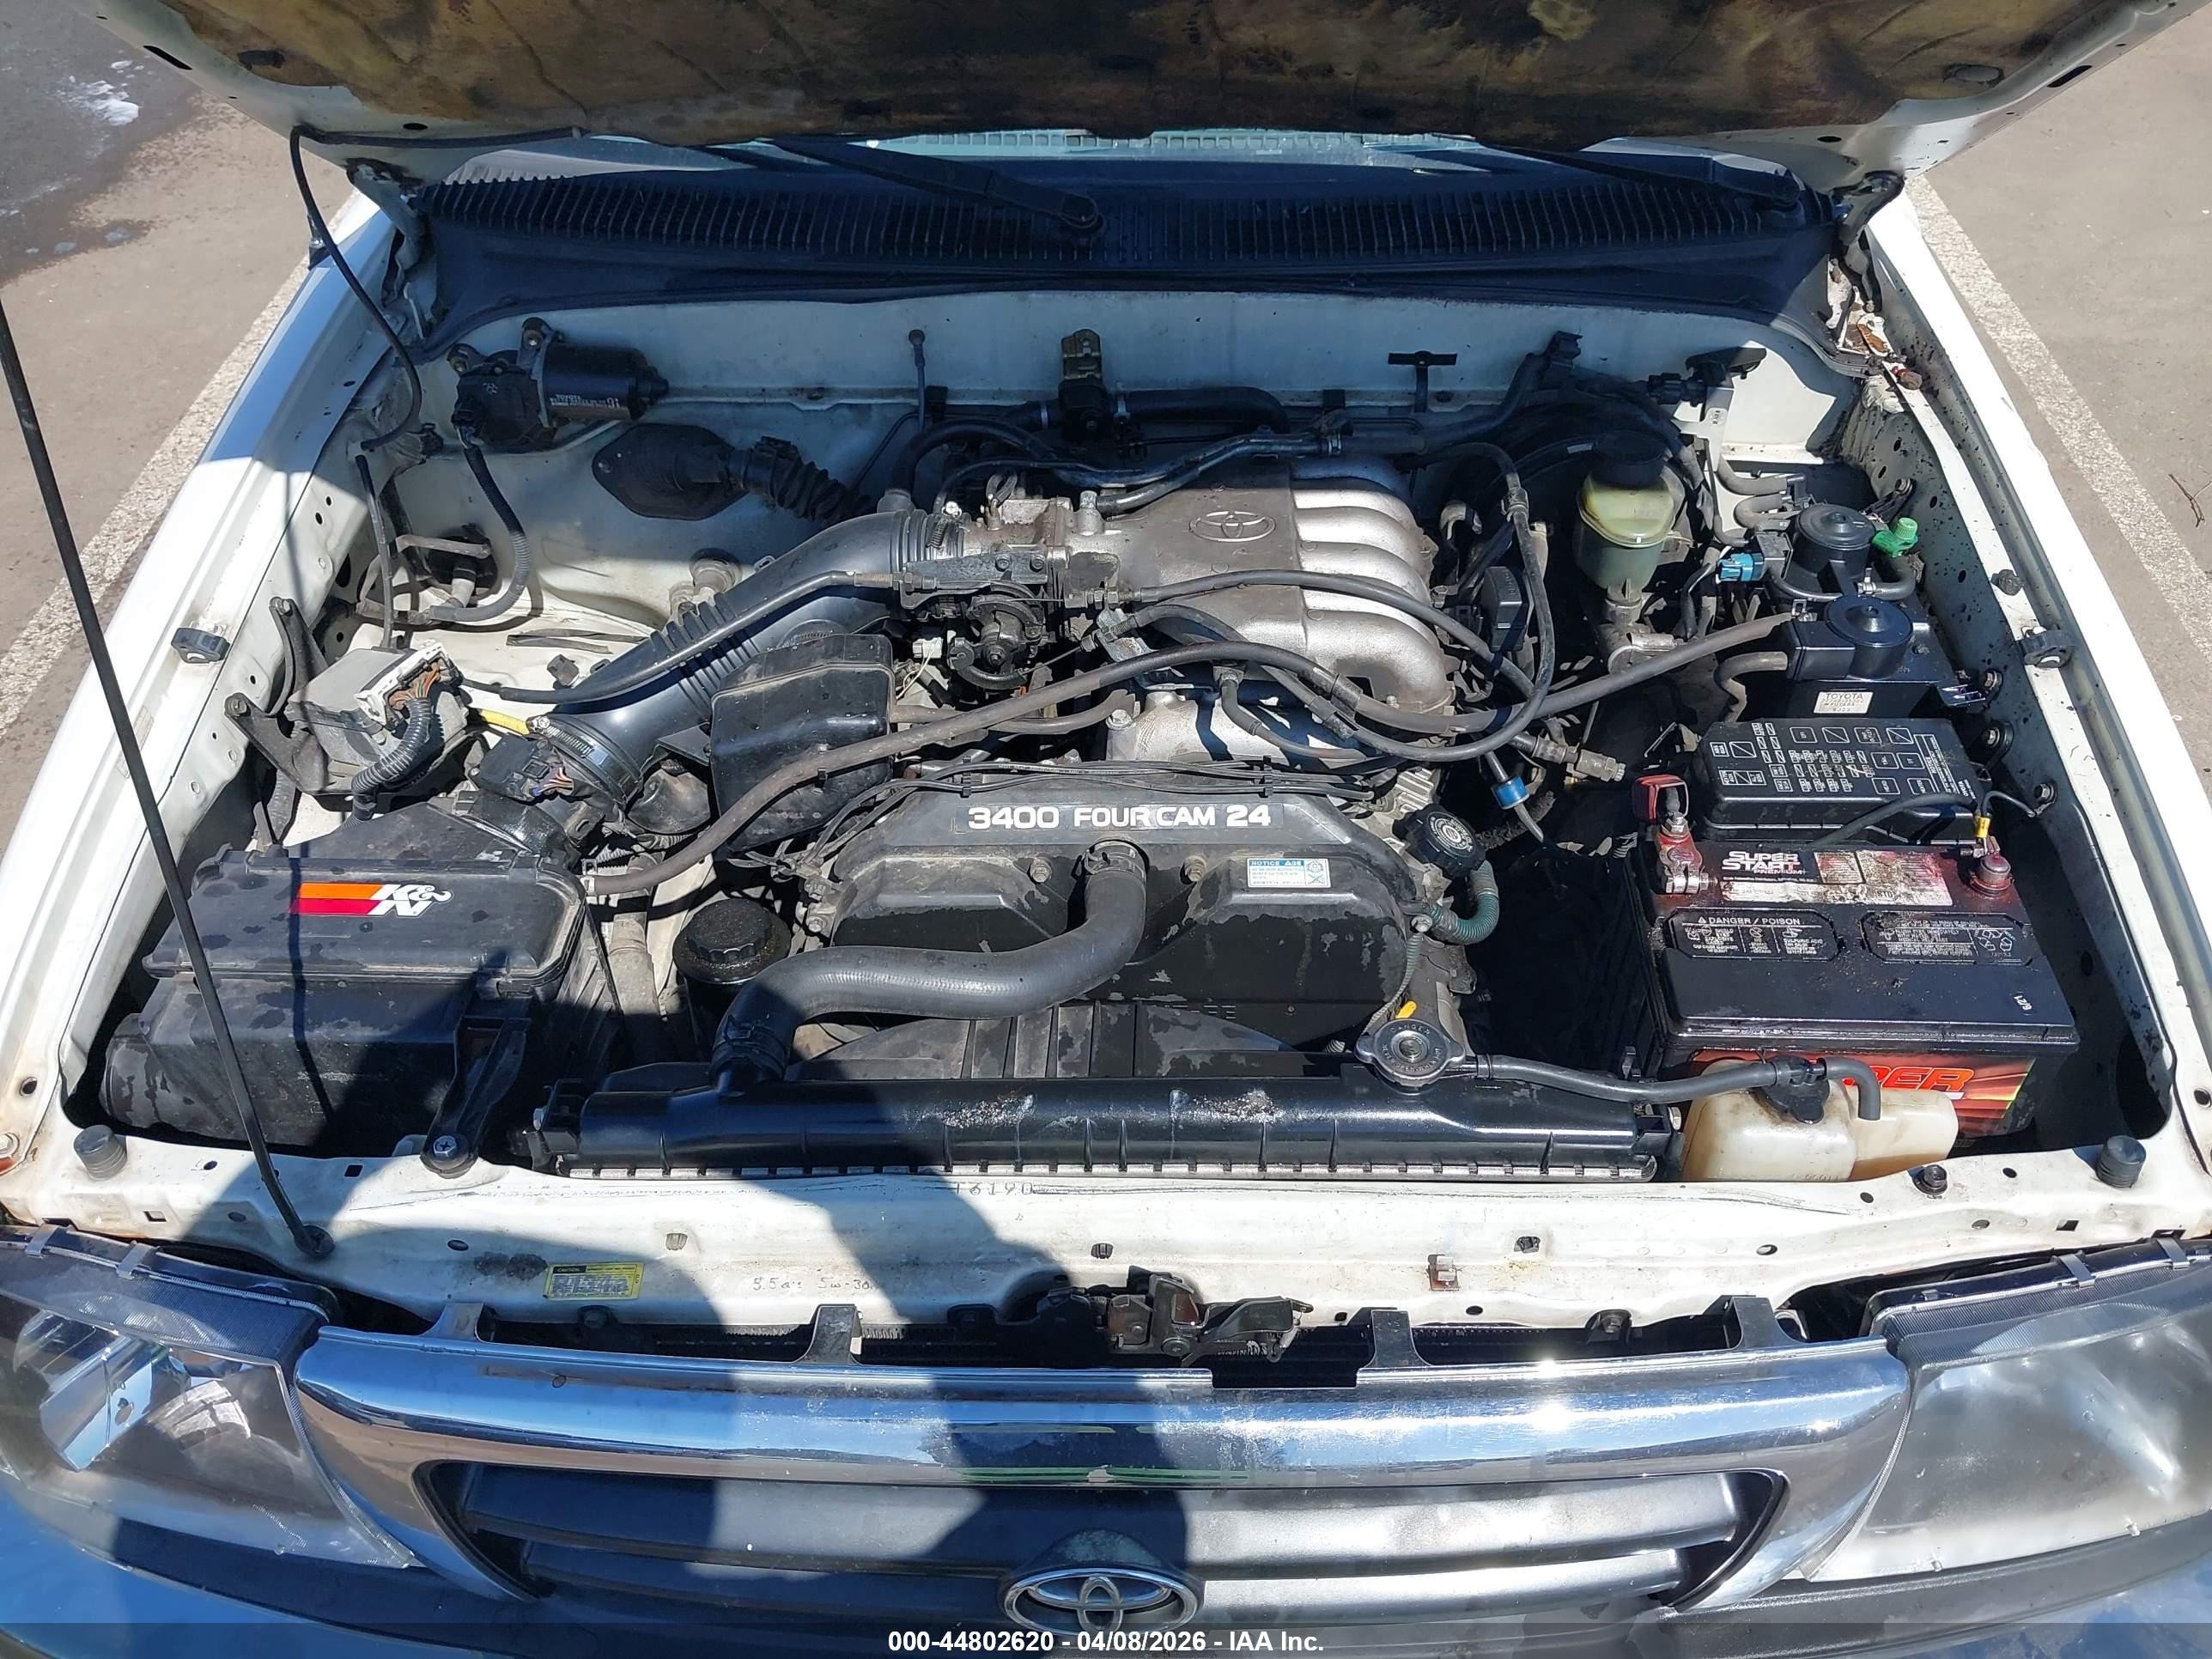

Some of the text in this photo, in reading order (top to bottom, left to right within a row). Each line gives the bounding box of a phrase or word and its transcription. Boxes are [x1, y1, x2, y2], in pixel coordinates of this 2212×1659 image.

[1925, 757, 1937, 774] NOTICE
[968, 805, 1271, 829] 3400 FOUR CAM 24
[1729, 851, 1799, 862] SUPER
[1721, 859, 1802, 871] START
[366, 884, 453, 917] K&N
[2014, 995, 2033, 1010] 6/21
